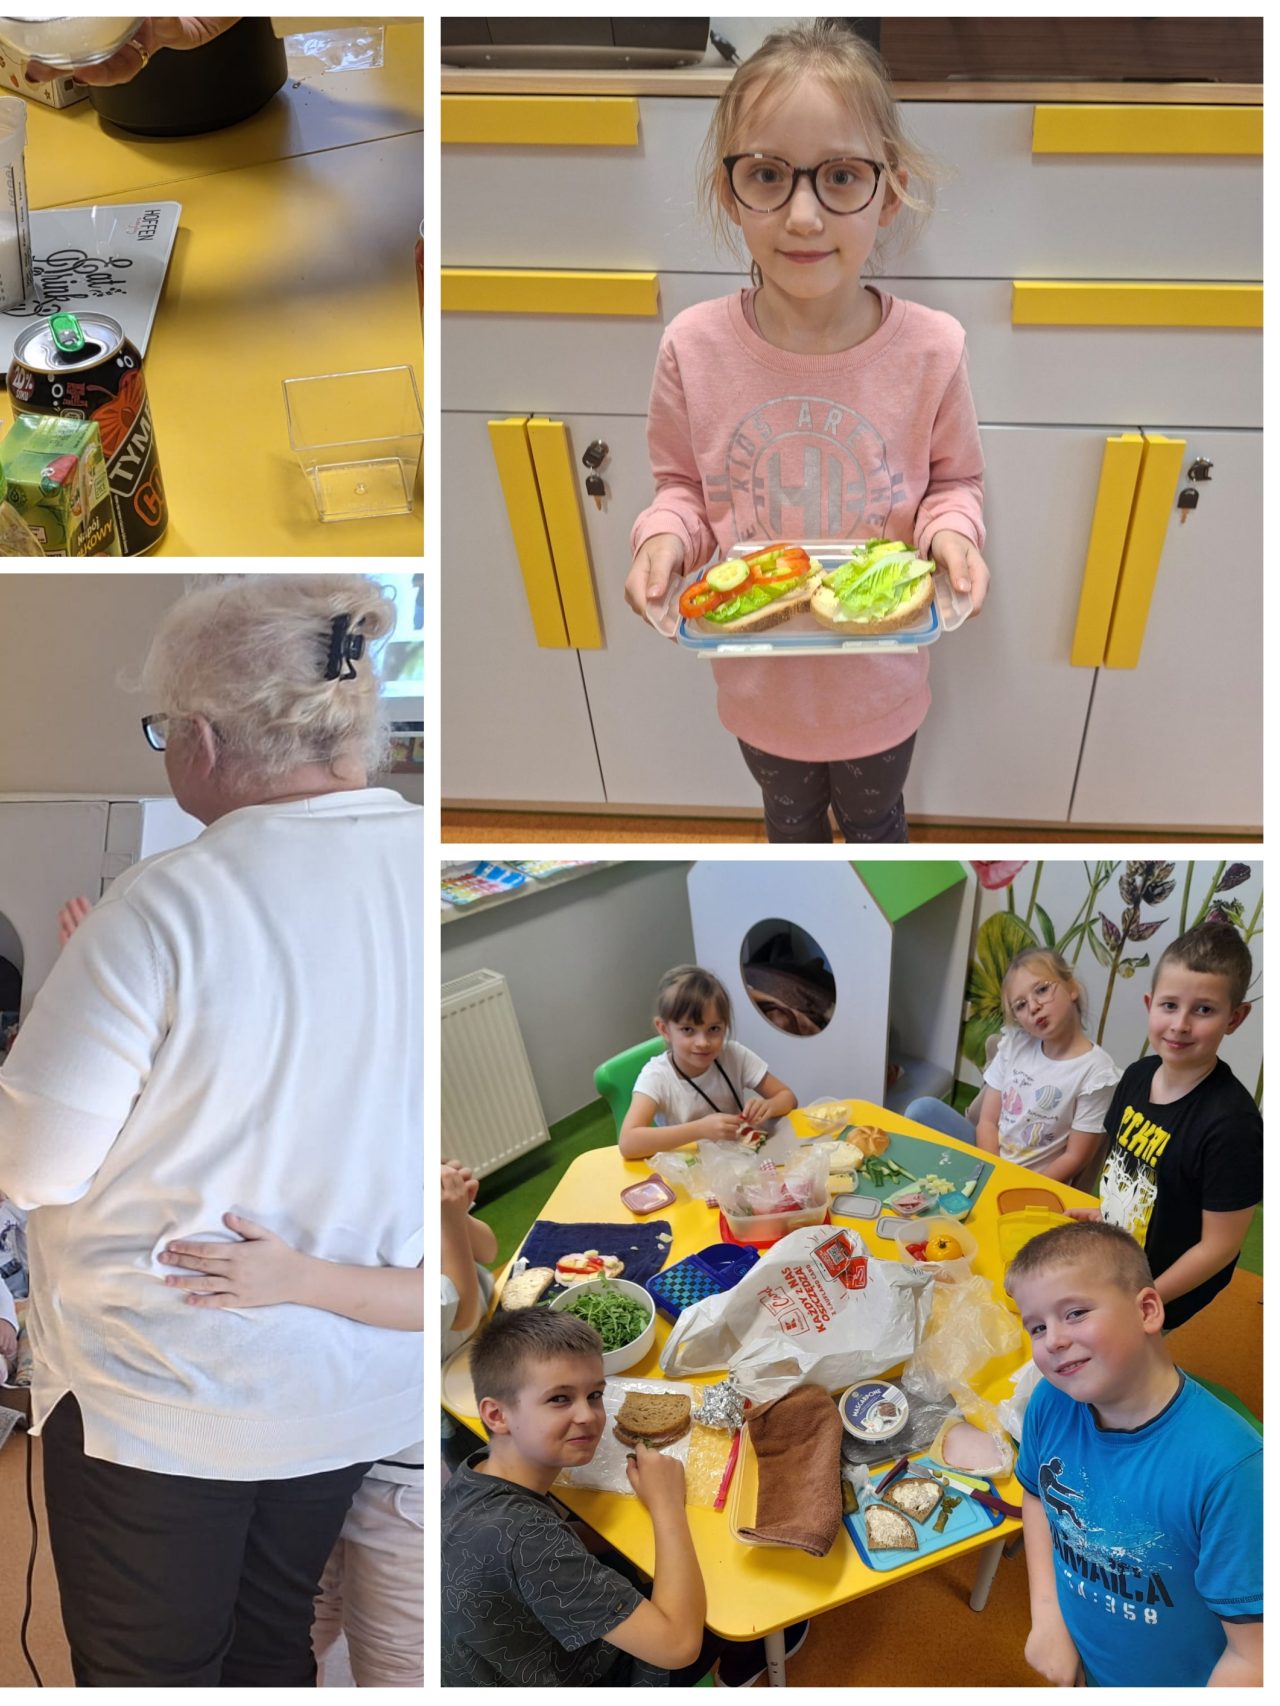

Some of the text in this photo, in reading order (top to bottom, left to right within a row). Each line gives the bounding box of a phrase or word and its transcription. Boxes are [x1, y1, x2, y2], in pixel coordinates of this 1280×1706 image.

[137, 209, 161, 241] HOFFEN
[74, 256, 134, 295] Eat
[13, 365, 34, 389] 20%
[16, 389, 29, 401] SOKU
[732, 411, 772, 493] KIDS
[797, 401, 869, 447] ARE
[781, 1266, 799, 1290] NAS
[792, 1265, 830, 1322] OSZCZĘDZA!
[798, 1296, 827, 1333] KAŻDY
[852, 1388, 883, 1417] MASCARPONE
